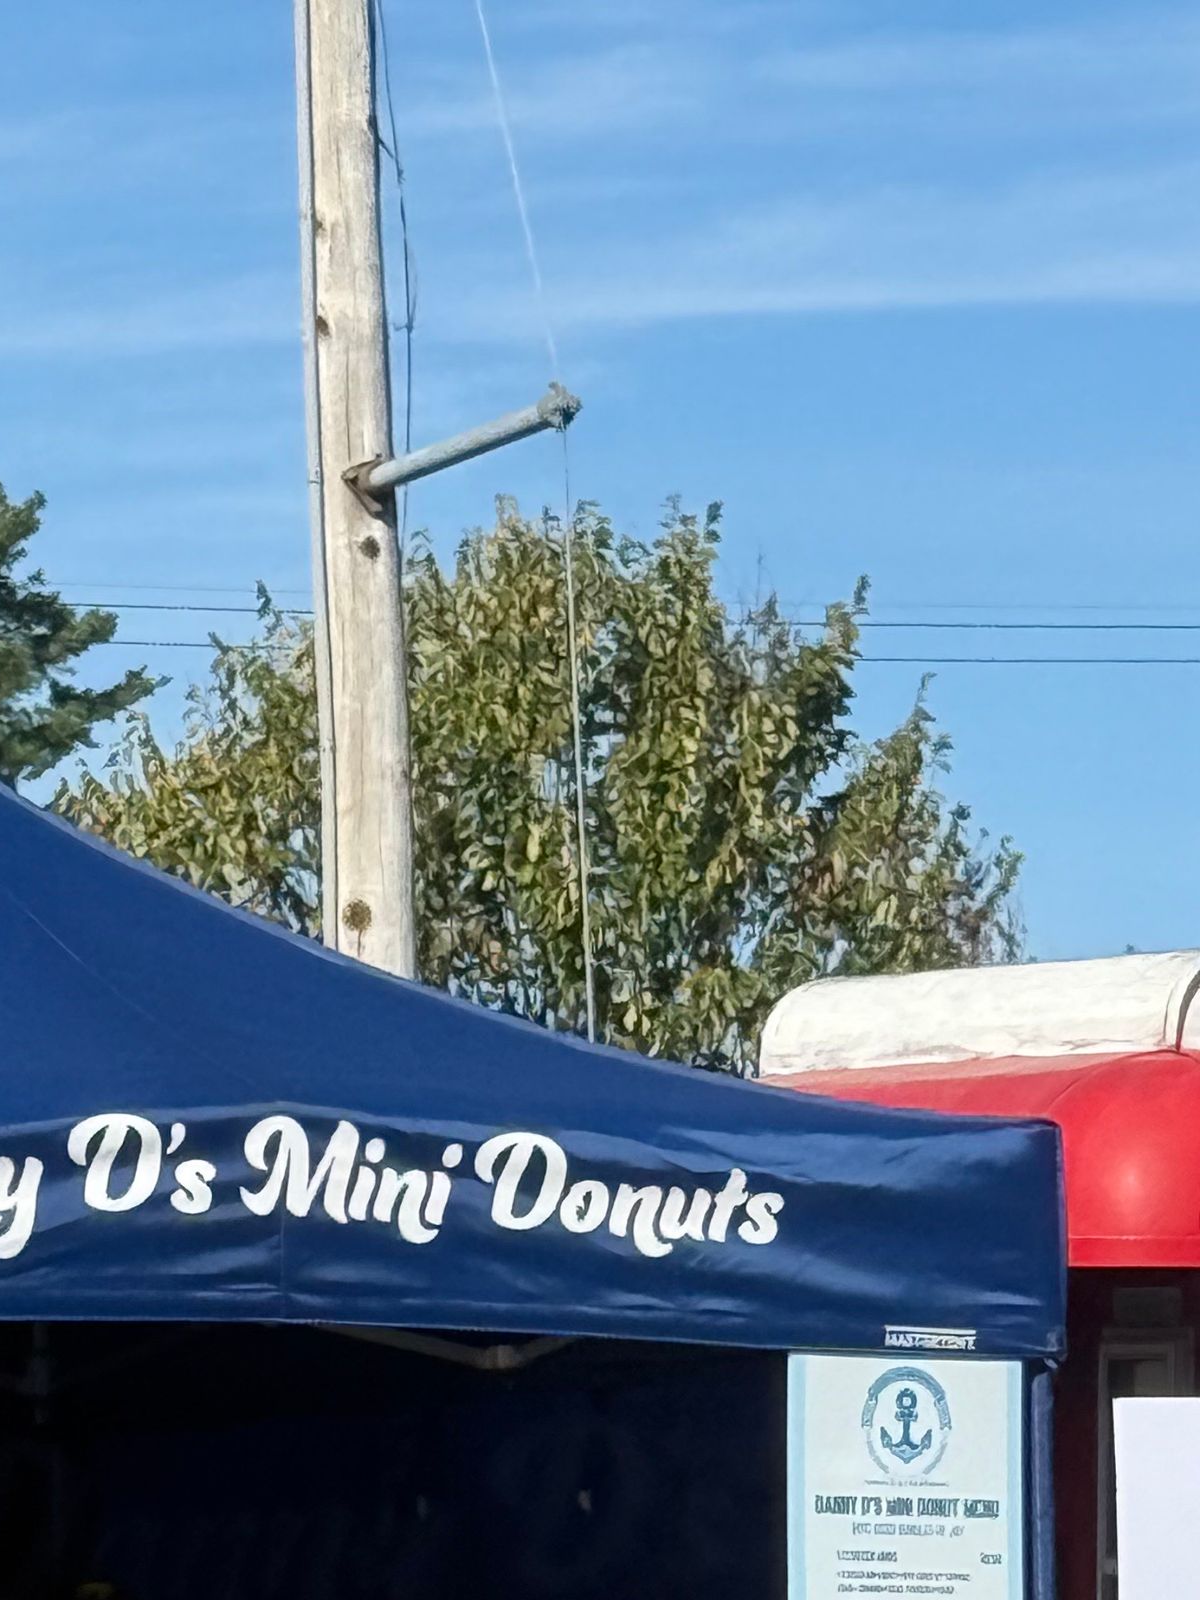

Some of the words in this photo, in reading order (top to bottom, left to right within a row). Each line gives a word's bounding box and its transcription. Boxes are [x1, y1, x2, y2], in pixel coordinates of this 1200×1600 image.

[67, 1113, 217, 1214] D's
[240, 1115, 463, 1244] Mini
[474, 1131, 785, 1258] Donuts
